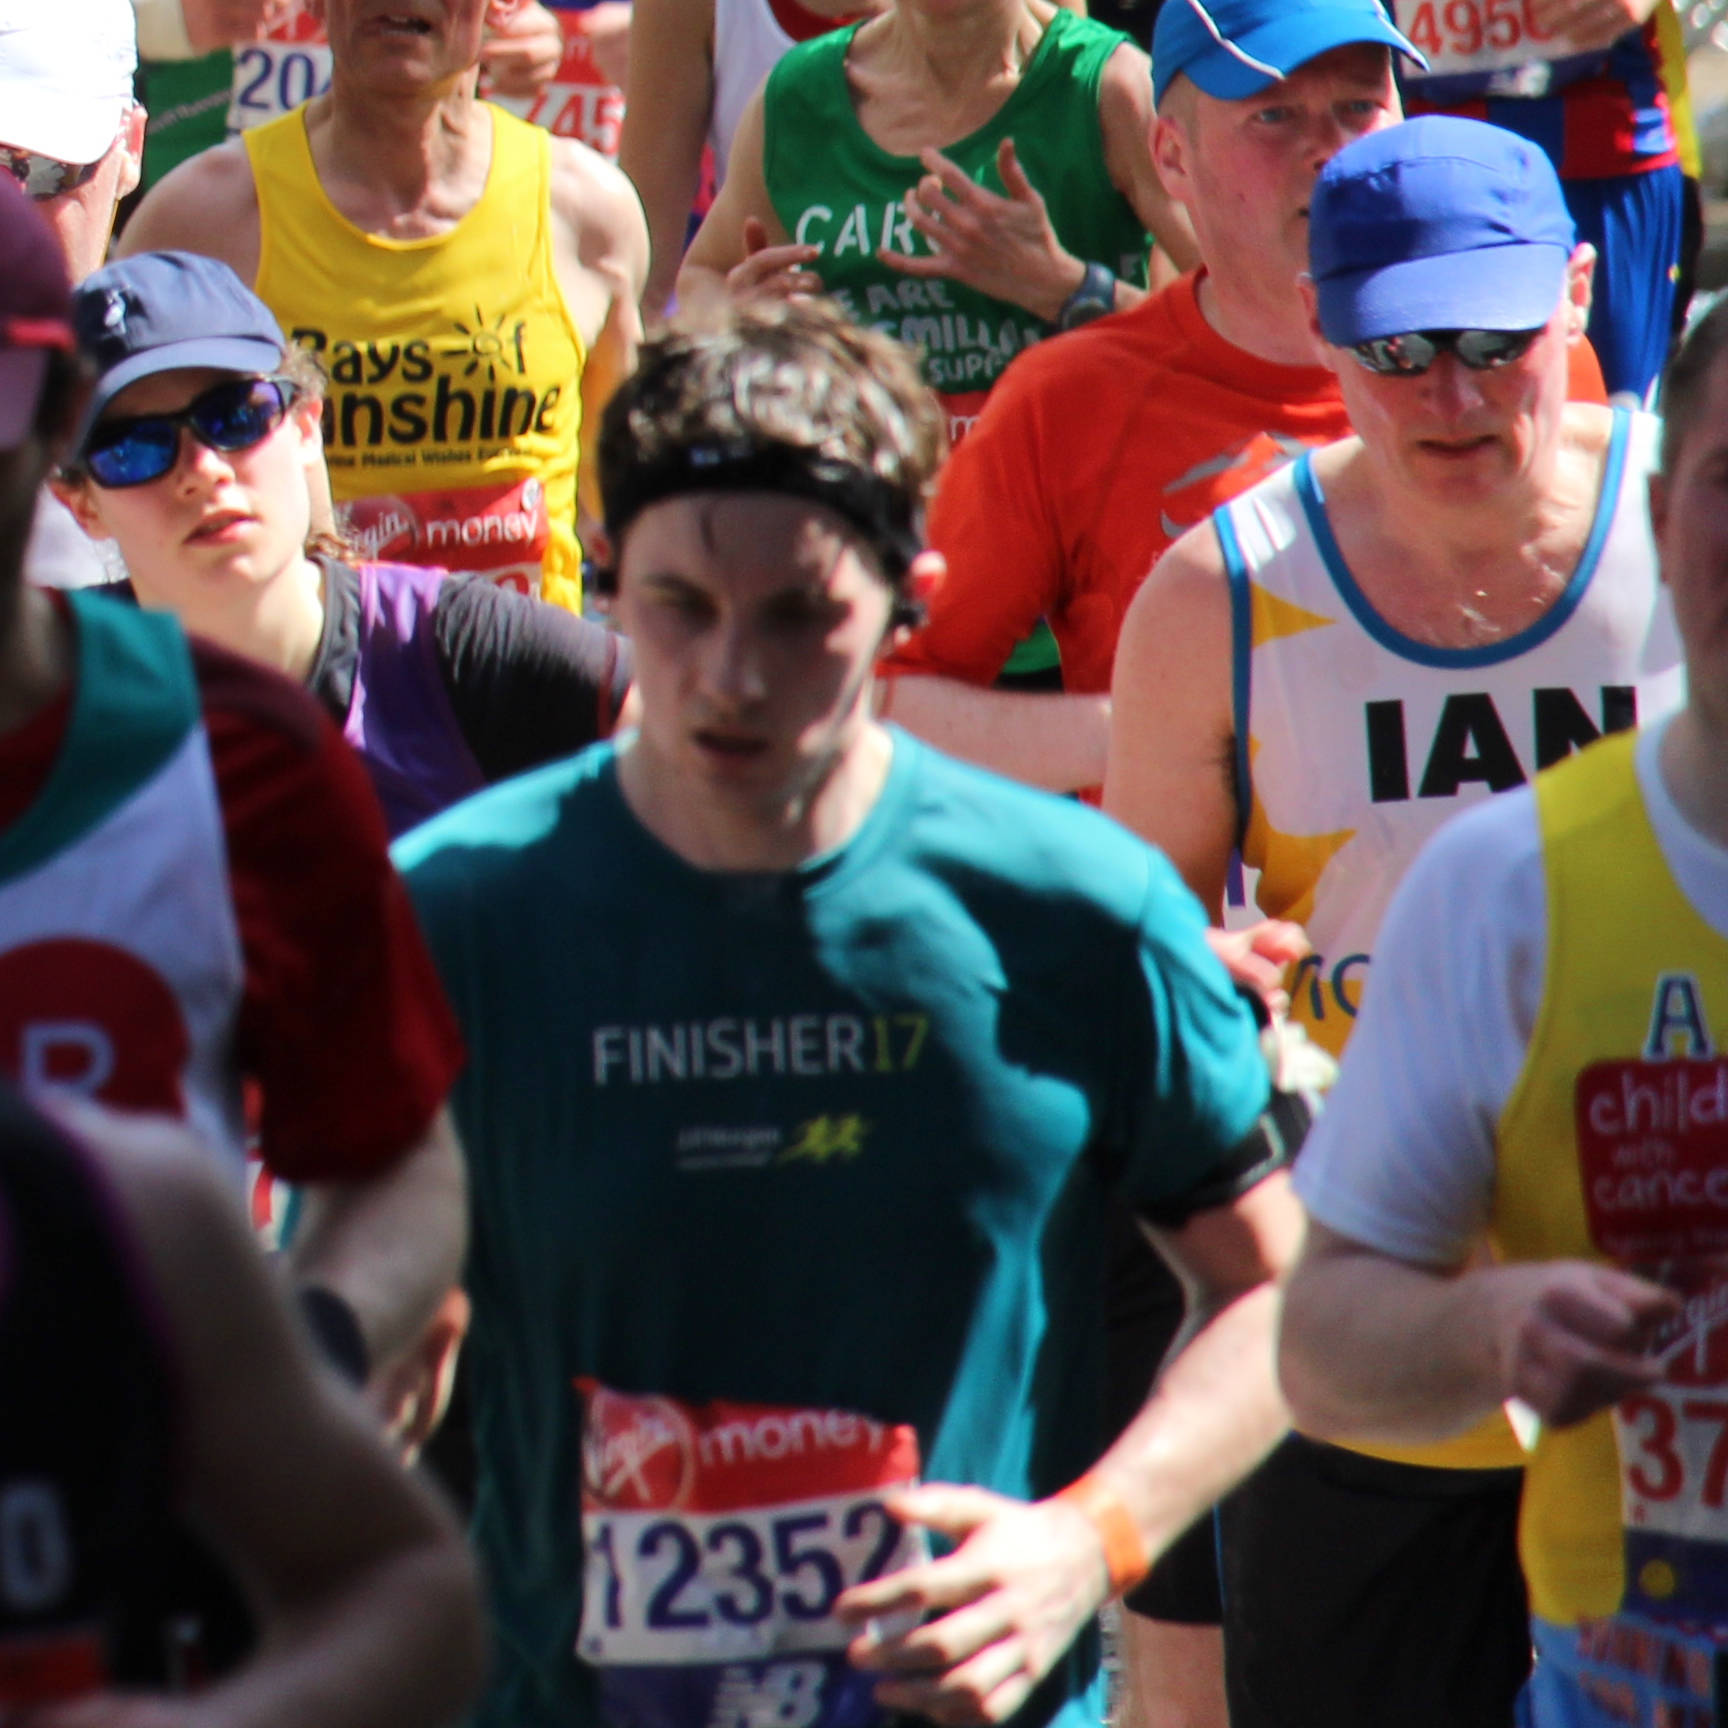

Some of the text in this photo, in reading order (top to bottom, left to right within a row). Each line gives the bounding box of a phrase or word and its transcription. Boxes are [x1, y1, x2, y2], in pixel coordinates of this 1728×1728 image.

[239, 48, 332, 112] 20
[426, 510, 538, 548] money
[1365, 686, 1638, 803] IAN
[593, 1500, 906, 1630] 12352
